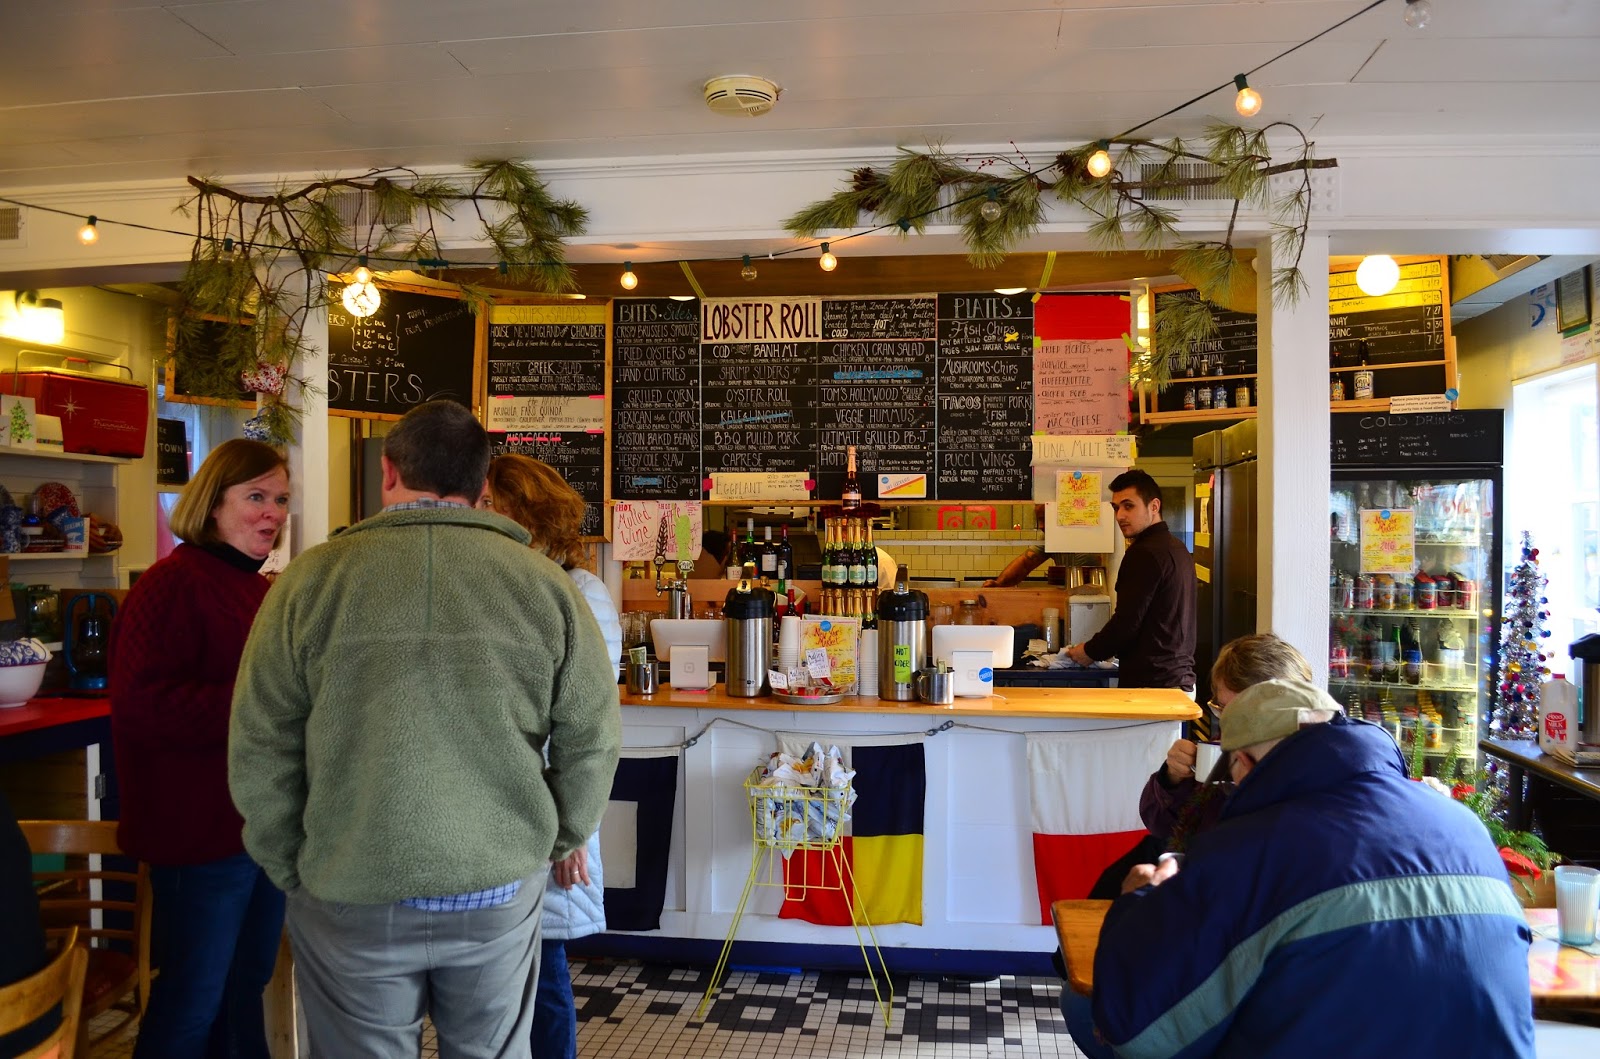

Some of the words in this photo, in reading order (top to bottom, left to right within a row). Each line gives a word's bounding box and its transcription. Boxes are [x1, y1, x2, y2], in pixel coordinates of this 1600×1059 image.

[619, 304, 657, 322] BITES
[954, 297, 1012, 318] PLATES
[1426, 307, 1431, 316] 7
[1434, 306, 1441, 314] 27
[704, 303, 777, 340] LOBSTER
[781, 303, 819, 338] ROLL
[873, 320, 888, 329] HOT
[987, 321, 1015, 335] Chips
[1329, 316, 1348, 326] NNAY
[616, 325, 636, 338] CRISPY
[638, 325, 668, 338] BRUSSELS
[670, 324, 698, 337] SPROUTS
[832, 329, 848, 338] COLD
[1428, 335, 1431, 345] 7
[618, 347, 642, 360] FRIED
[646, 346, 685, 360] OYSTERS
[713, 345, 730, 358] COD
[753, 344, 780, 357] BANH
[782, 344, 798, 357] MI
[833, 344, 869, 357] CHICKEN
[872, 343, 894, 356] CRAN
[897, 343, 925, 356] SALAD
[528, 362, 555, 374] GREEK
[719, 366, 750, 380] SHRIMP
[753, 366, 790, 380] SLIDERS
[941, 359, 990, 375] MUSHROOMS
[619, 368, 641, 382] HAND
[644, 368, 660, 382] CUT
[662, 368, 686, 382] FRIES
[328, 369, 425, 404] STERS
[628, 389, 662, 402] GRILLED
[667, 389, 694, 402] CORN
[726, 388, 763, 402] OYSTER
[768, 388, 790, 402] ROLL
[821, 387, 848, 401] TOM'S
[850, 387, 899, 401] HOLLYWOOD
[939, 396, 981, 410] TACOS
[1009, 396, 1029, 409] PORK
[617, 411, 651, 424] MEXICAN
[668, 411, 694, 423] CORN
[835, 409, 863, 423] VEGGIE
[870, 409, 915, 423] HUMMUS
[991, 410, 1007, 420] FISH
[1072, 414, 1100, 427] CHEESE
[1360, 416, 1408, 429] COLD
[618, 433, 645, 445] BOSTON
[648, 433, 671, 445] BAKED
[674, 433, 698, 445] BEANS
[714, 432, 740, 445] BBQ
[746, 432, 773, 445] PULLED
[777, 432, 801, 445] PORK
[821, 431, 860, 444] ULTIMATE
[865, 430, 900, 444] GRILLED
[158, 443, 183, 453] TOWN
[1034, 442, 1066, 458] TUNA
[1071, 440, 1101, 457] MELT
[619, 454, 641, 467] HERBY
[643, 454, 659, 467] COLE
[663, 454, 684, 467] SLAW
[722, 453, 763, 467] CAPRESE
[945, 452, 974, 467] PUCCI
[980, 452, 1015, 467] WINGS
[618, 502, 651, 529] Mulled
[620, 525, 654, 545] Wine
[895, 660, 910, 668] CIDER
